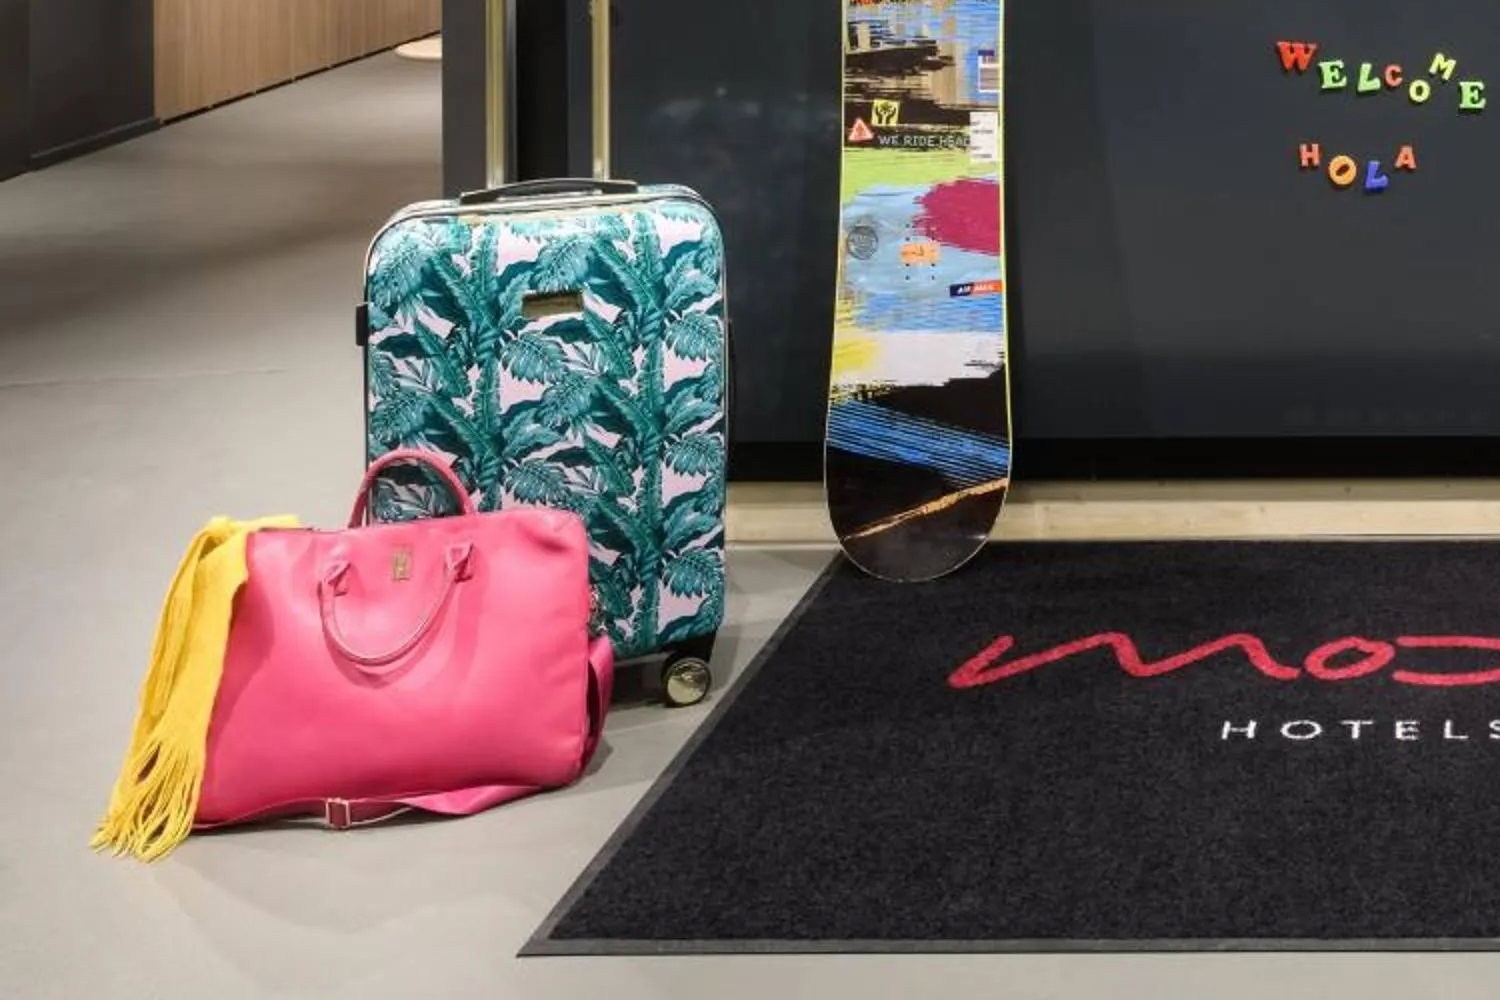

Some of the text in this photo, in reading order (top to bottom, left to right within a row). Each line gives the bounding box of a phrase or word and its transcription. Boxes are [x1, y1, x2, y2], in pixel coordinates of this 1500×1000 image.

[1276, 40, 1487, 110] WELCOME
[903, 135, 935, 147] RIDE
[1300, 143, 1417, 189] HOLA
